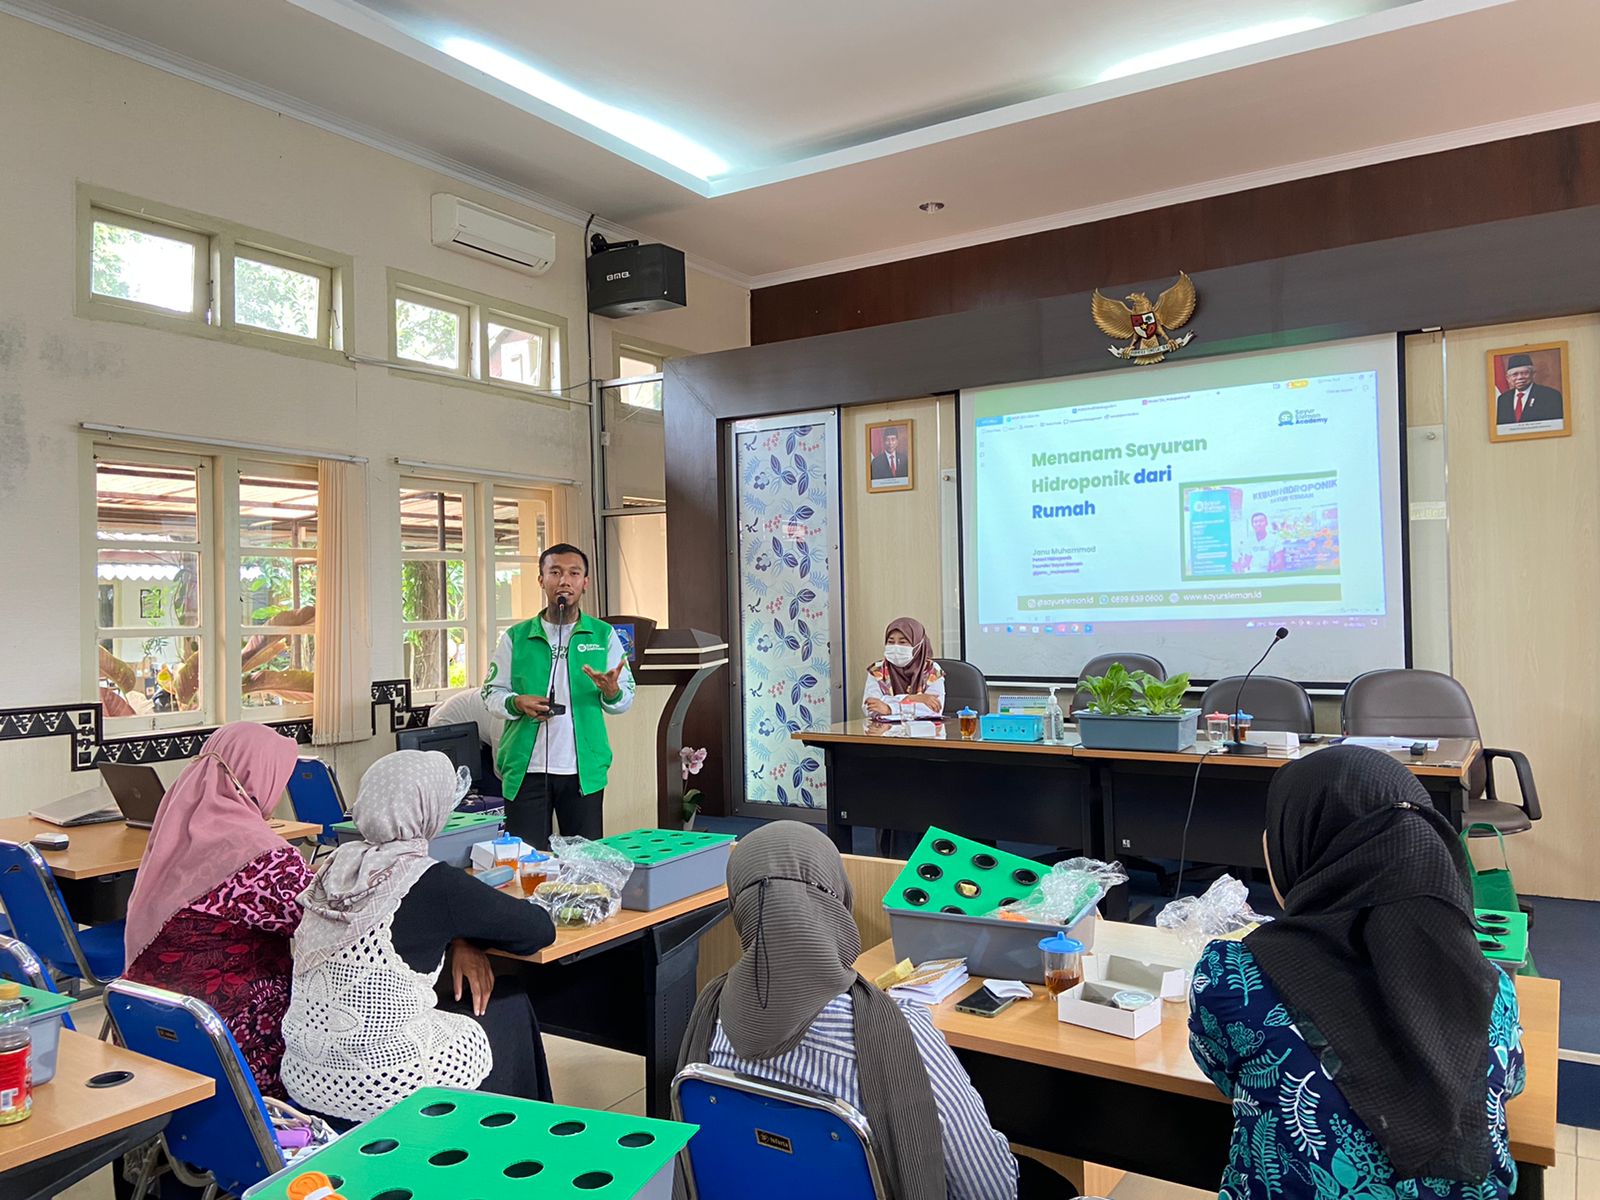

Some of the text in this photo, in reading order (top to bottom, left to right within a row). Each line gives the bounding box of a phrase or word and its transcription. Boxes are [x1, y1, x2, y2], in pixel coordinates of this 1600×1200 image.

[1032, 438, 1207, 467] Menanam Sayuran
[1032, 465, 1172, 494] Hidroponik dari
[1032, 500, 1096, 519] Rumah
[1051, 546, 1096, 555] Muhammad
